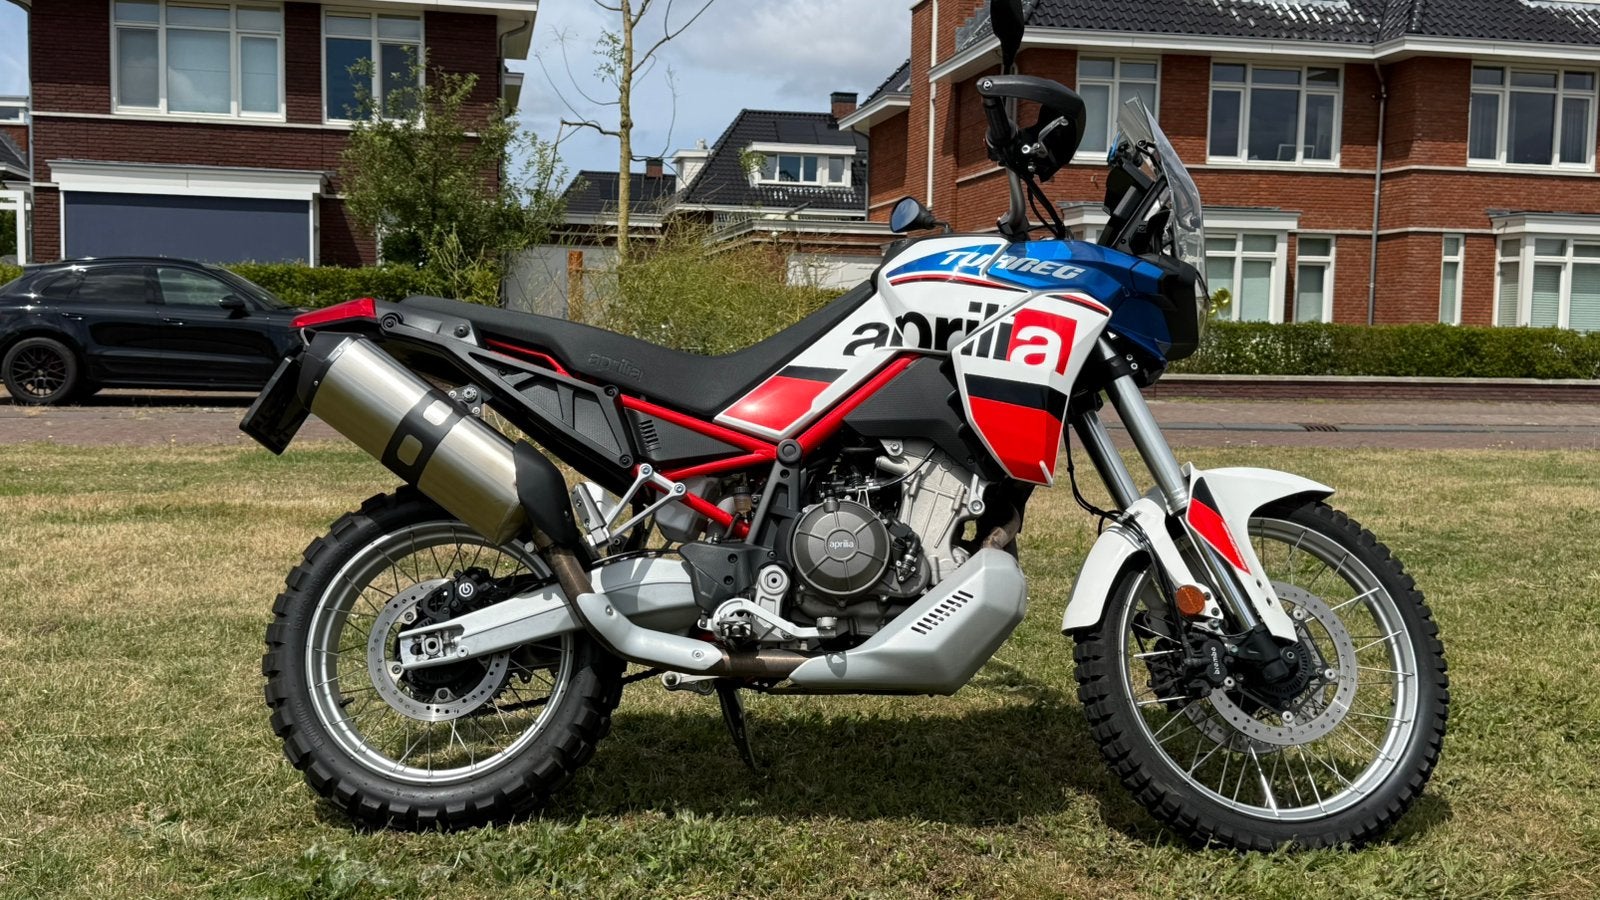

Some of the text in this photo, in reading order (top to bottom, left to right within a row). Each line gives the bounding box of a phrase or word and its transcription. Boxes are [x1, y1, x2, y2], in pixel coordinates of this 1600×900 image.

[939, 250, 1086, 280] TUAREG
[843, 301, 1073, 373] aprilia
[588, 353, 643, 381] aprilia
[829, 540, 854, 550] aprilia
[1210, 646, 1220, 675] brembo
